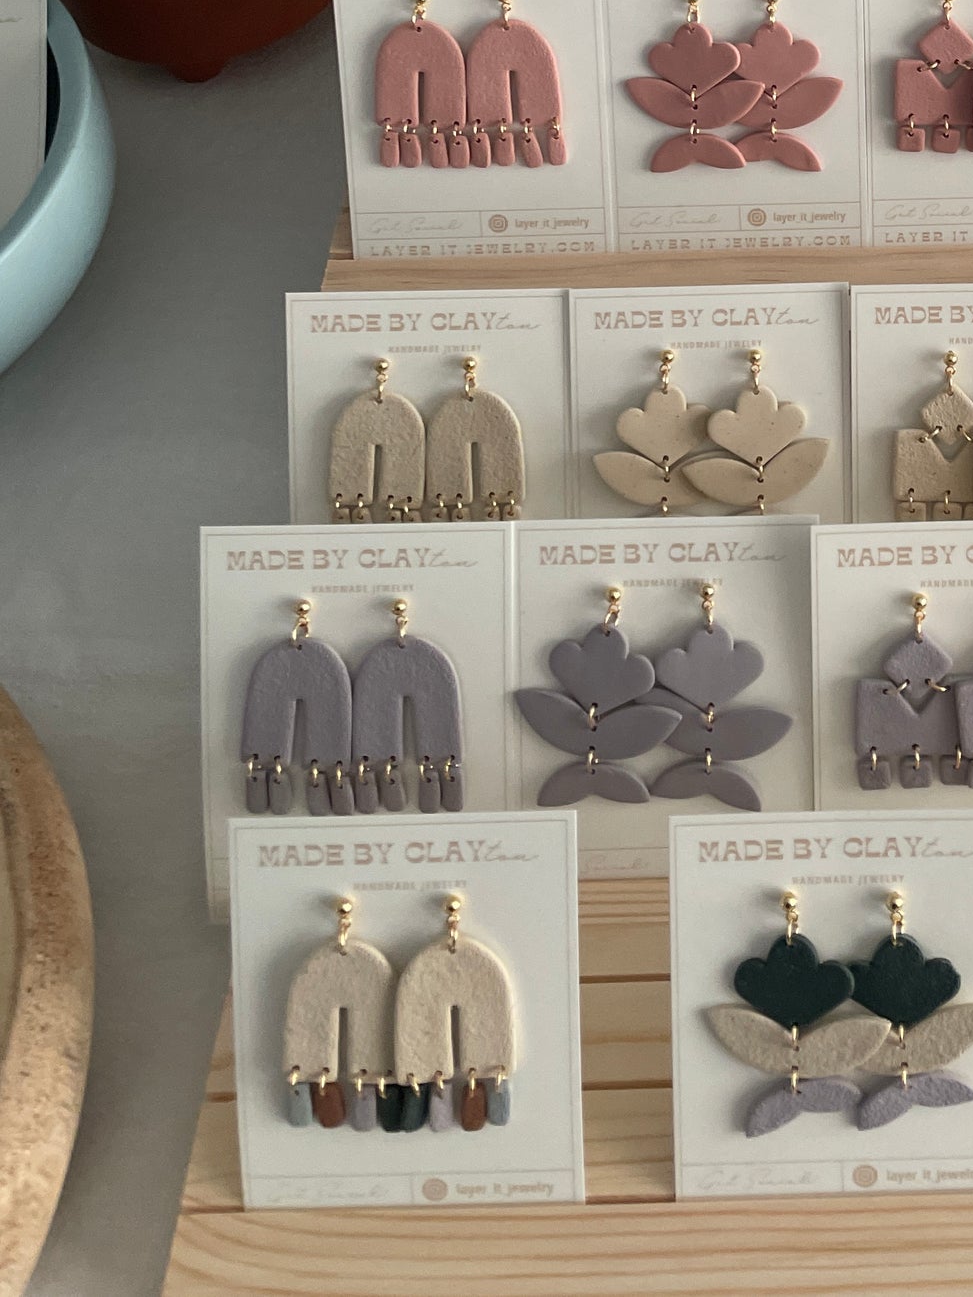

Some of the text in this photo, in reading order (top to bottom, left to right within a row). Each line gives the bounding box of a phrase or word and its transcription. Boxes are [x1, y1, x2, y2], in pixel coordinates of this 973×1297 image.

[310, 313, 382, 333] MADE
[387, 313, 421, 332] BY
[593, 311, 664, 330] MADE
[671, 310, 704, 328] BY
[875, 306, 943, 325] MADE
[226, 550, 304, 571] MADE
[312, 549, 349, 570] BY
[539, 544, 616, 566] MADE
[624, 543, 660, 564] BY
[837, 546, 913, 568] MADE
[921, 545, 957, 566] BY
[259, 843, 344, 867] MADE
[353, 843, 394, 866] BY
[699, 839, 784, 863] MADE
[793, 837, 832, 860] BY
